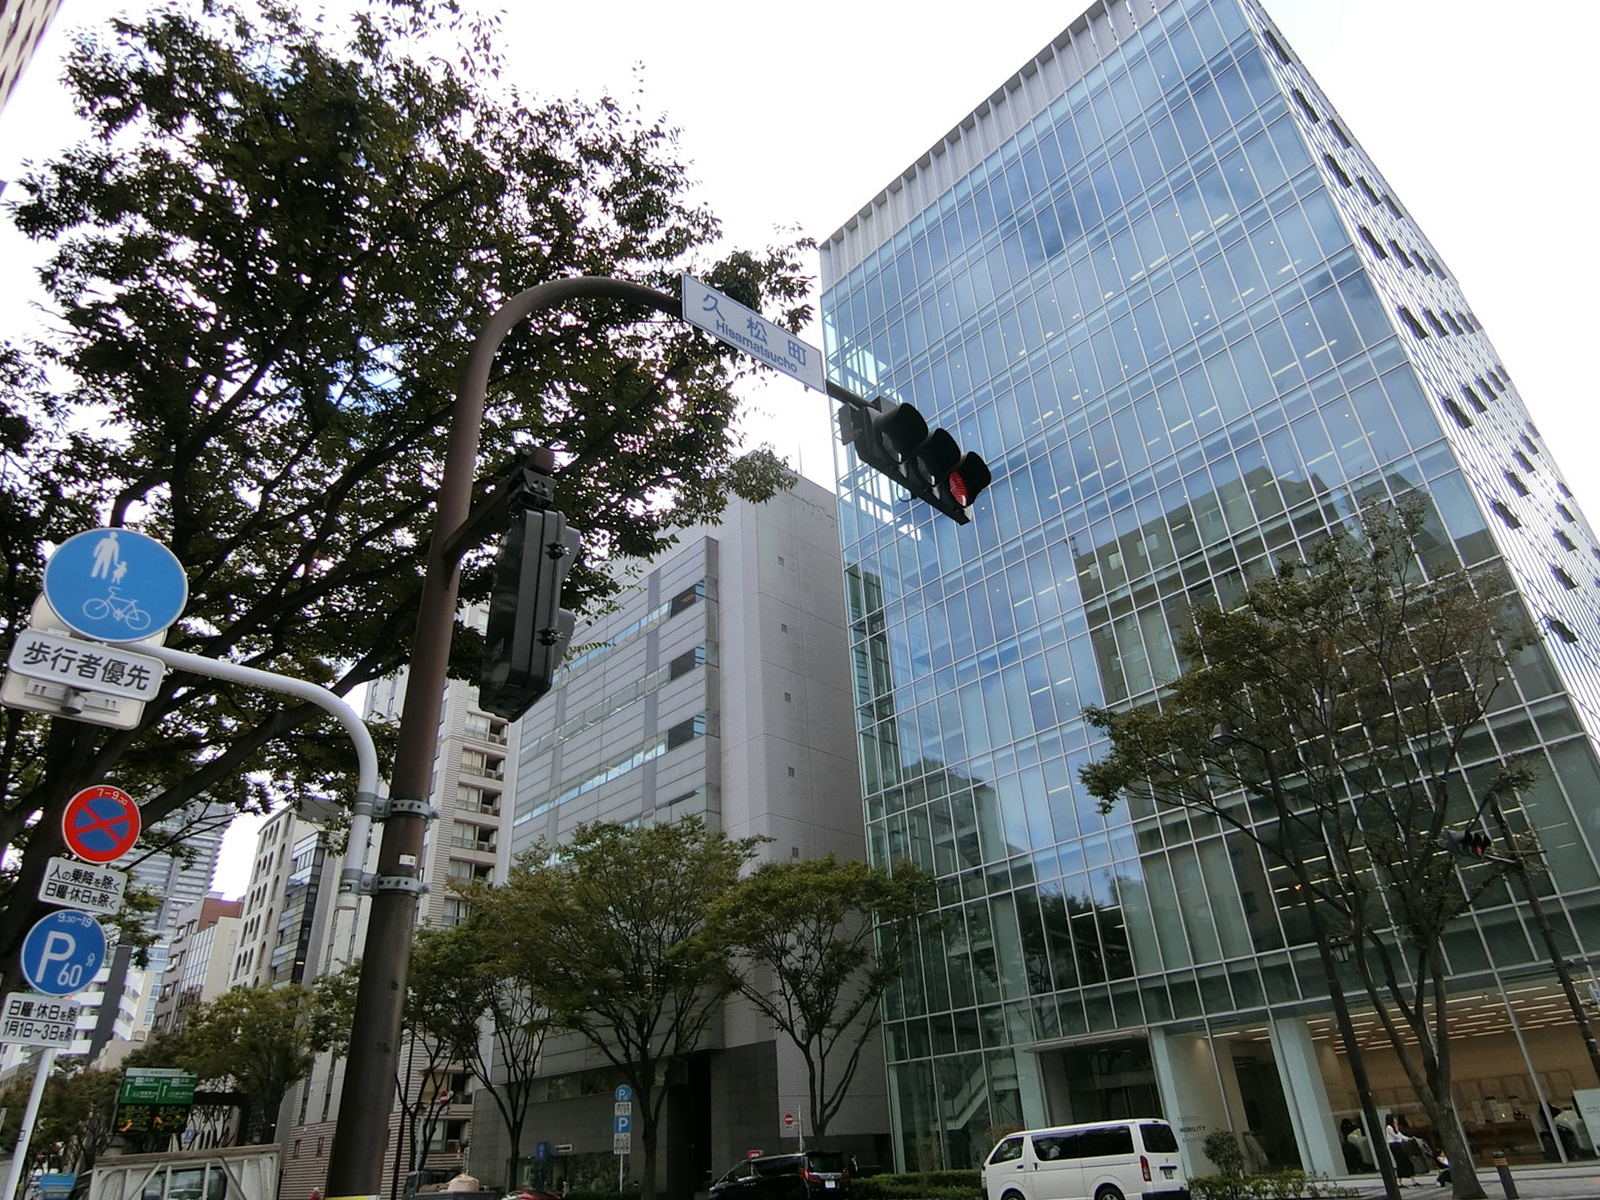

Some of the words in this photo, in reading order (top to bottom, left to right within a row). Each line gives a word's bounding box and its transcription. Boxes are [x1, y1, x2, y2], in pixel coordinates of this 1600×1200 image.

[703, 293, 807, 366] 久松町
[715, 318, 798, 373] Hisamatsucho
[23, 641, 151, 691] 歩行者優先
[49, 864, 122, 892] 人の乗降を除く
[35, 930, 76, 983] P
[618, 1089, 626, 1100] P
[619, 1117, 628, 1131] P
